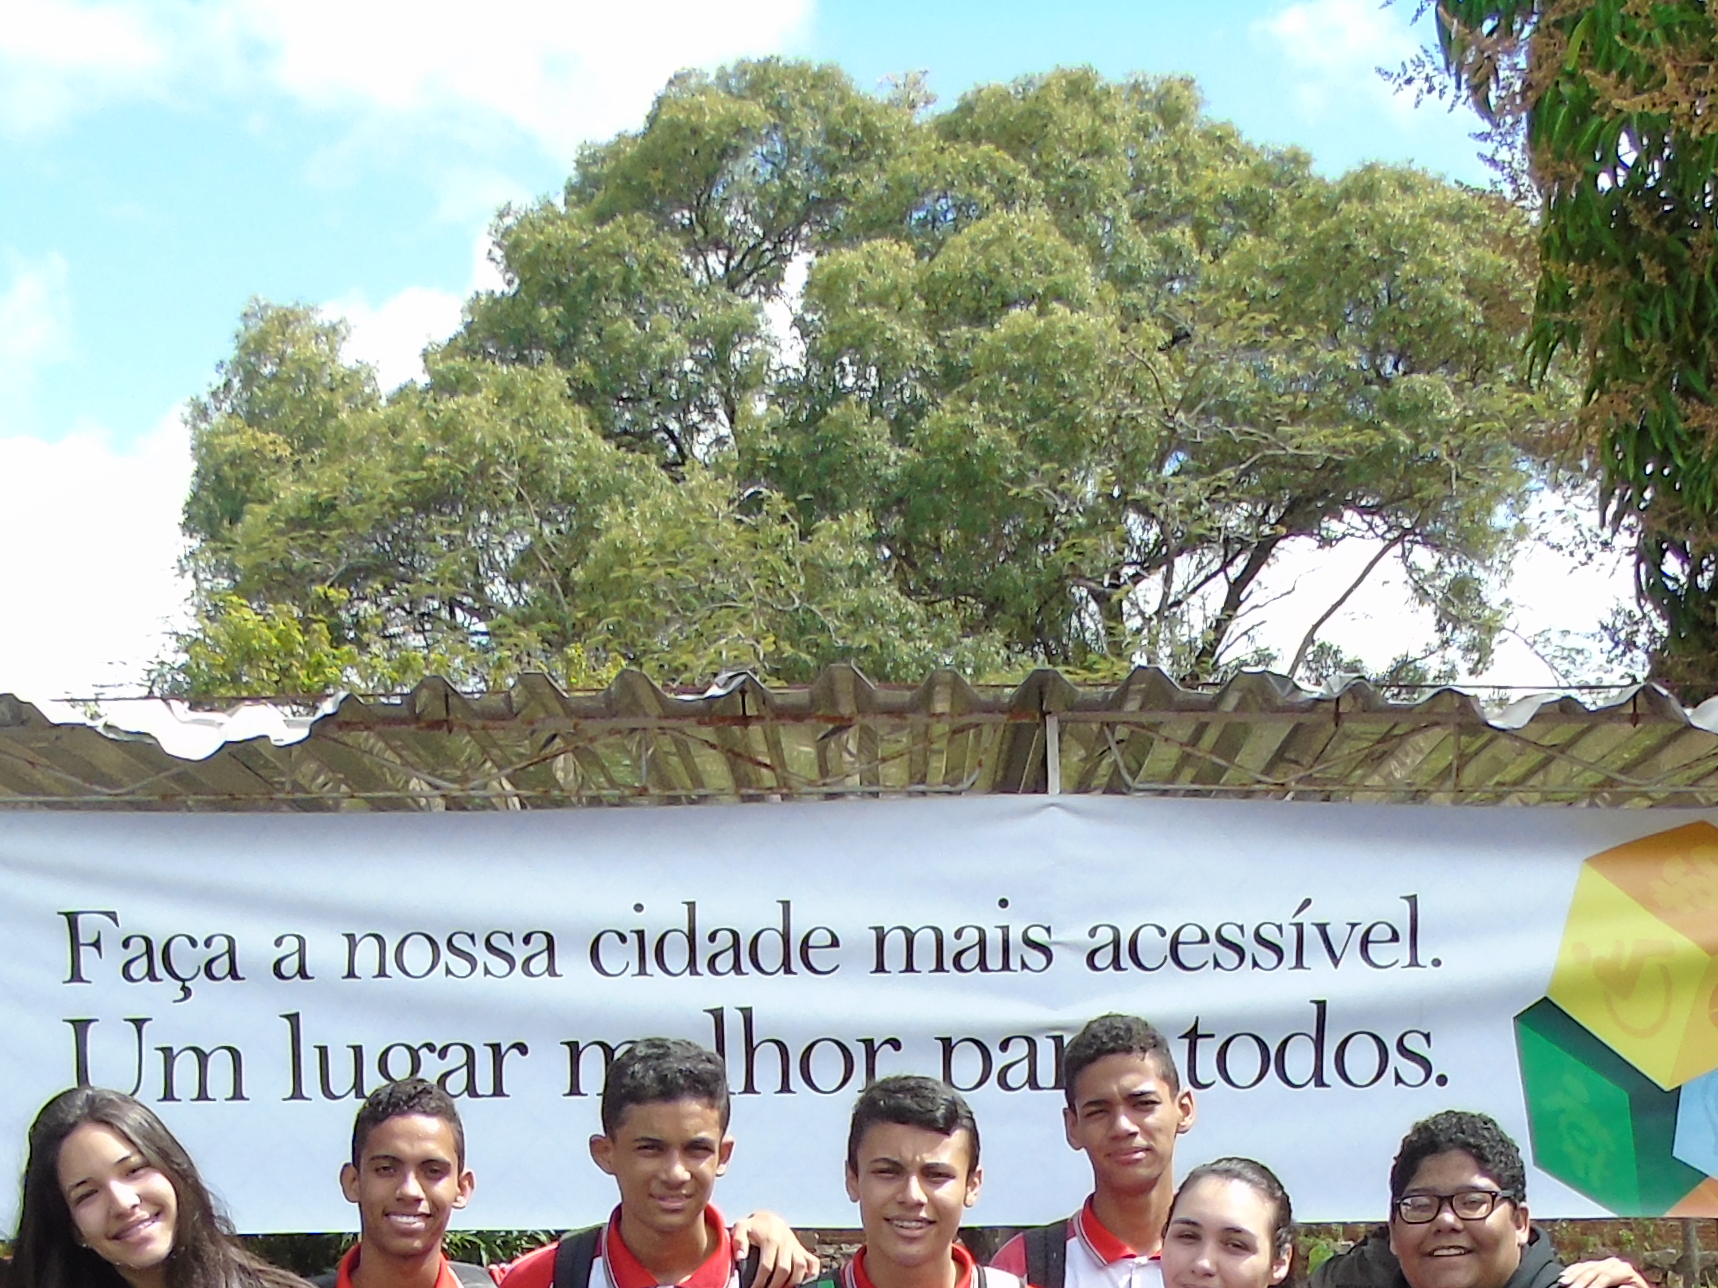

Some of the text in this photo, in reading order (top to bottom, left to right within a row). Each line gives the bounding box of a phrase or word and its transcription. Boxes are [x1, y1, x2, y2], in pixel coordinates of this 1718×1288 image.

[57, 893, 1443, 1004] Faça a nossa cidade mais acessível.
[62, 1017, 251, 1102] Um
[559, 1005, 903, 1098] mlhor
[1176, 999, 1449, 1090] todos.
